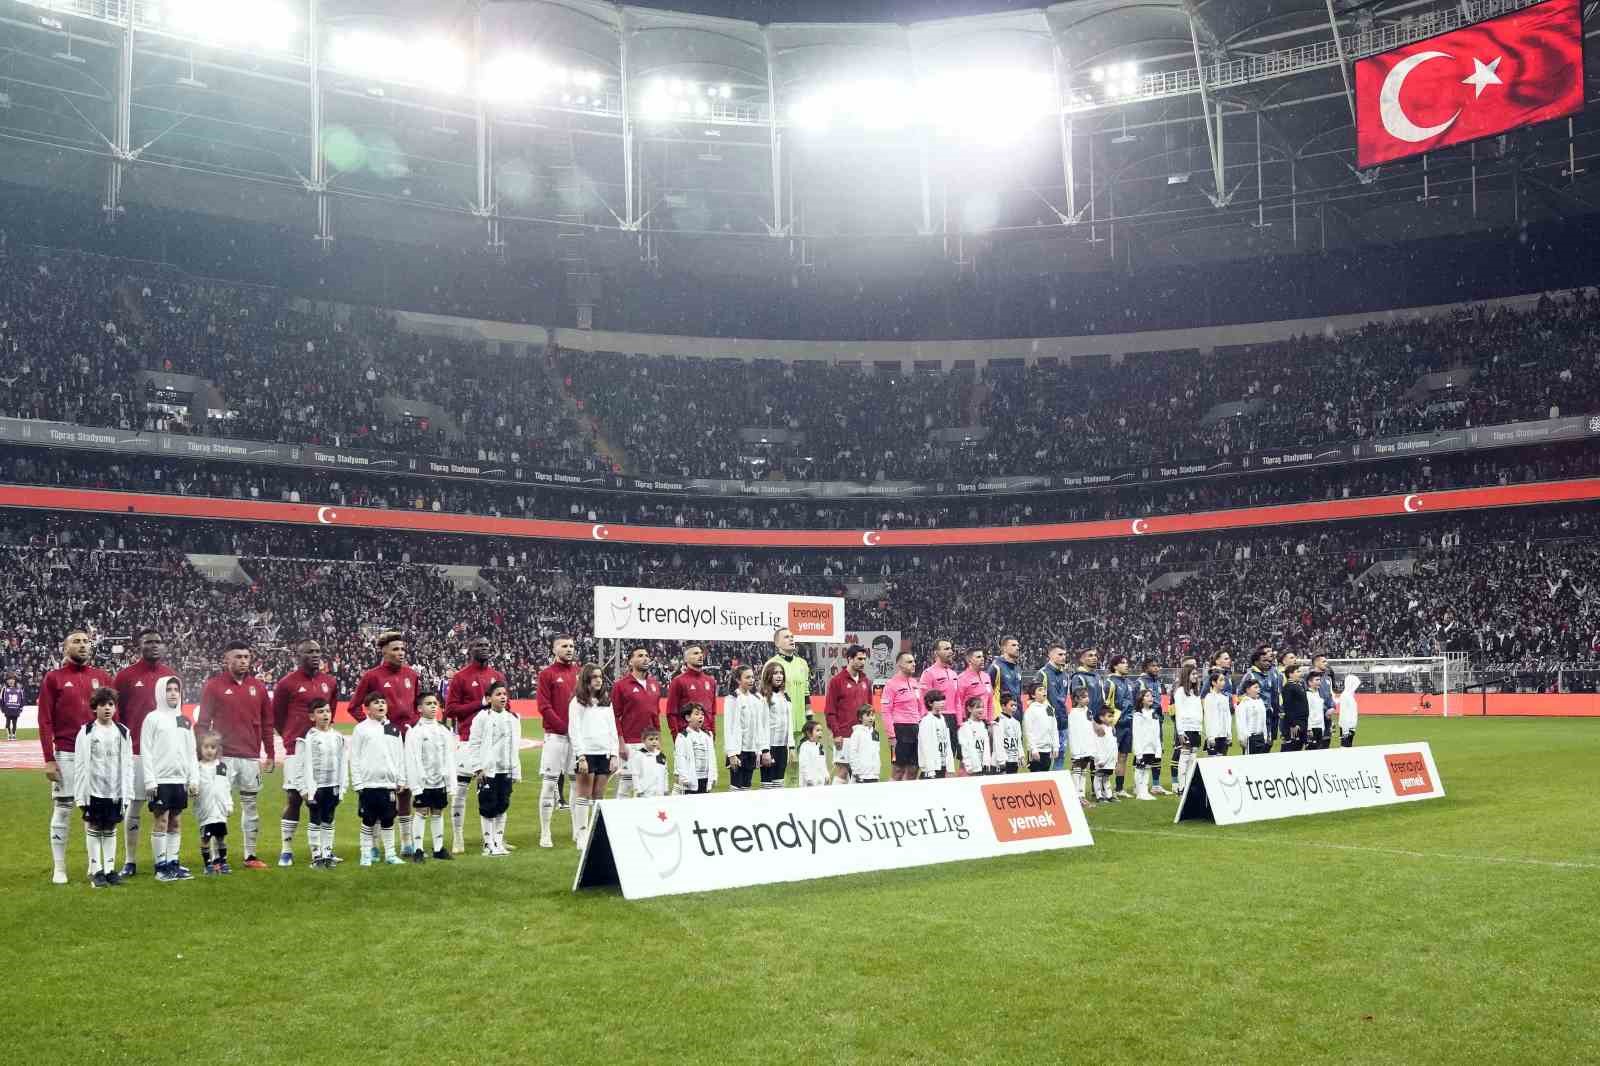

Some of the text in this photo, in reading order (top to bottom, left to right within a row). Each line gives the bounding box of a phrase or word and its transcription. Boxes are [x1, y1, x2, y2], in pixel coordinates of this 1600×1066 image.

[637, 603, 782, 630] trendyol SüperLig
[793, 607, 830, 620] trendyol
[798, 621, 826, 632] yemek
[1390, 758, 1424, 773] trendyol
[1245, 769, 1381, 801] trendyol SüperLig
[1400, 776, 1425, 791] yemek
[992, 788, 1055, 811] trendyol
[692, 808, 971, 857] trendyol SüperLig
[1008, 812, 1055, 834] yemek
